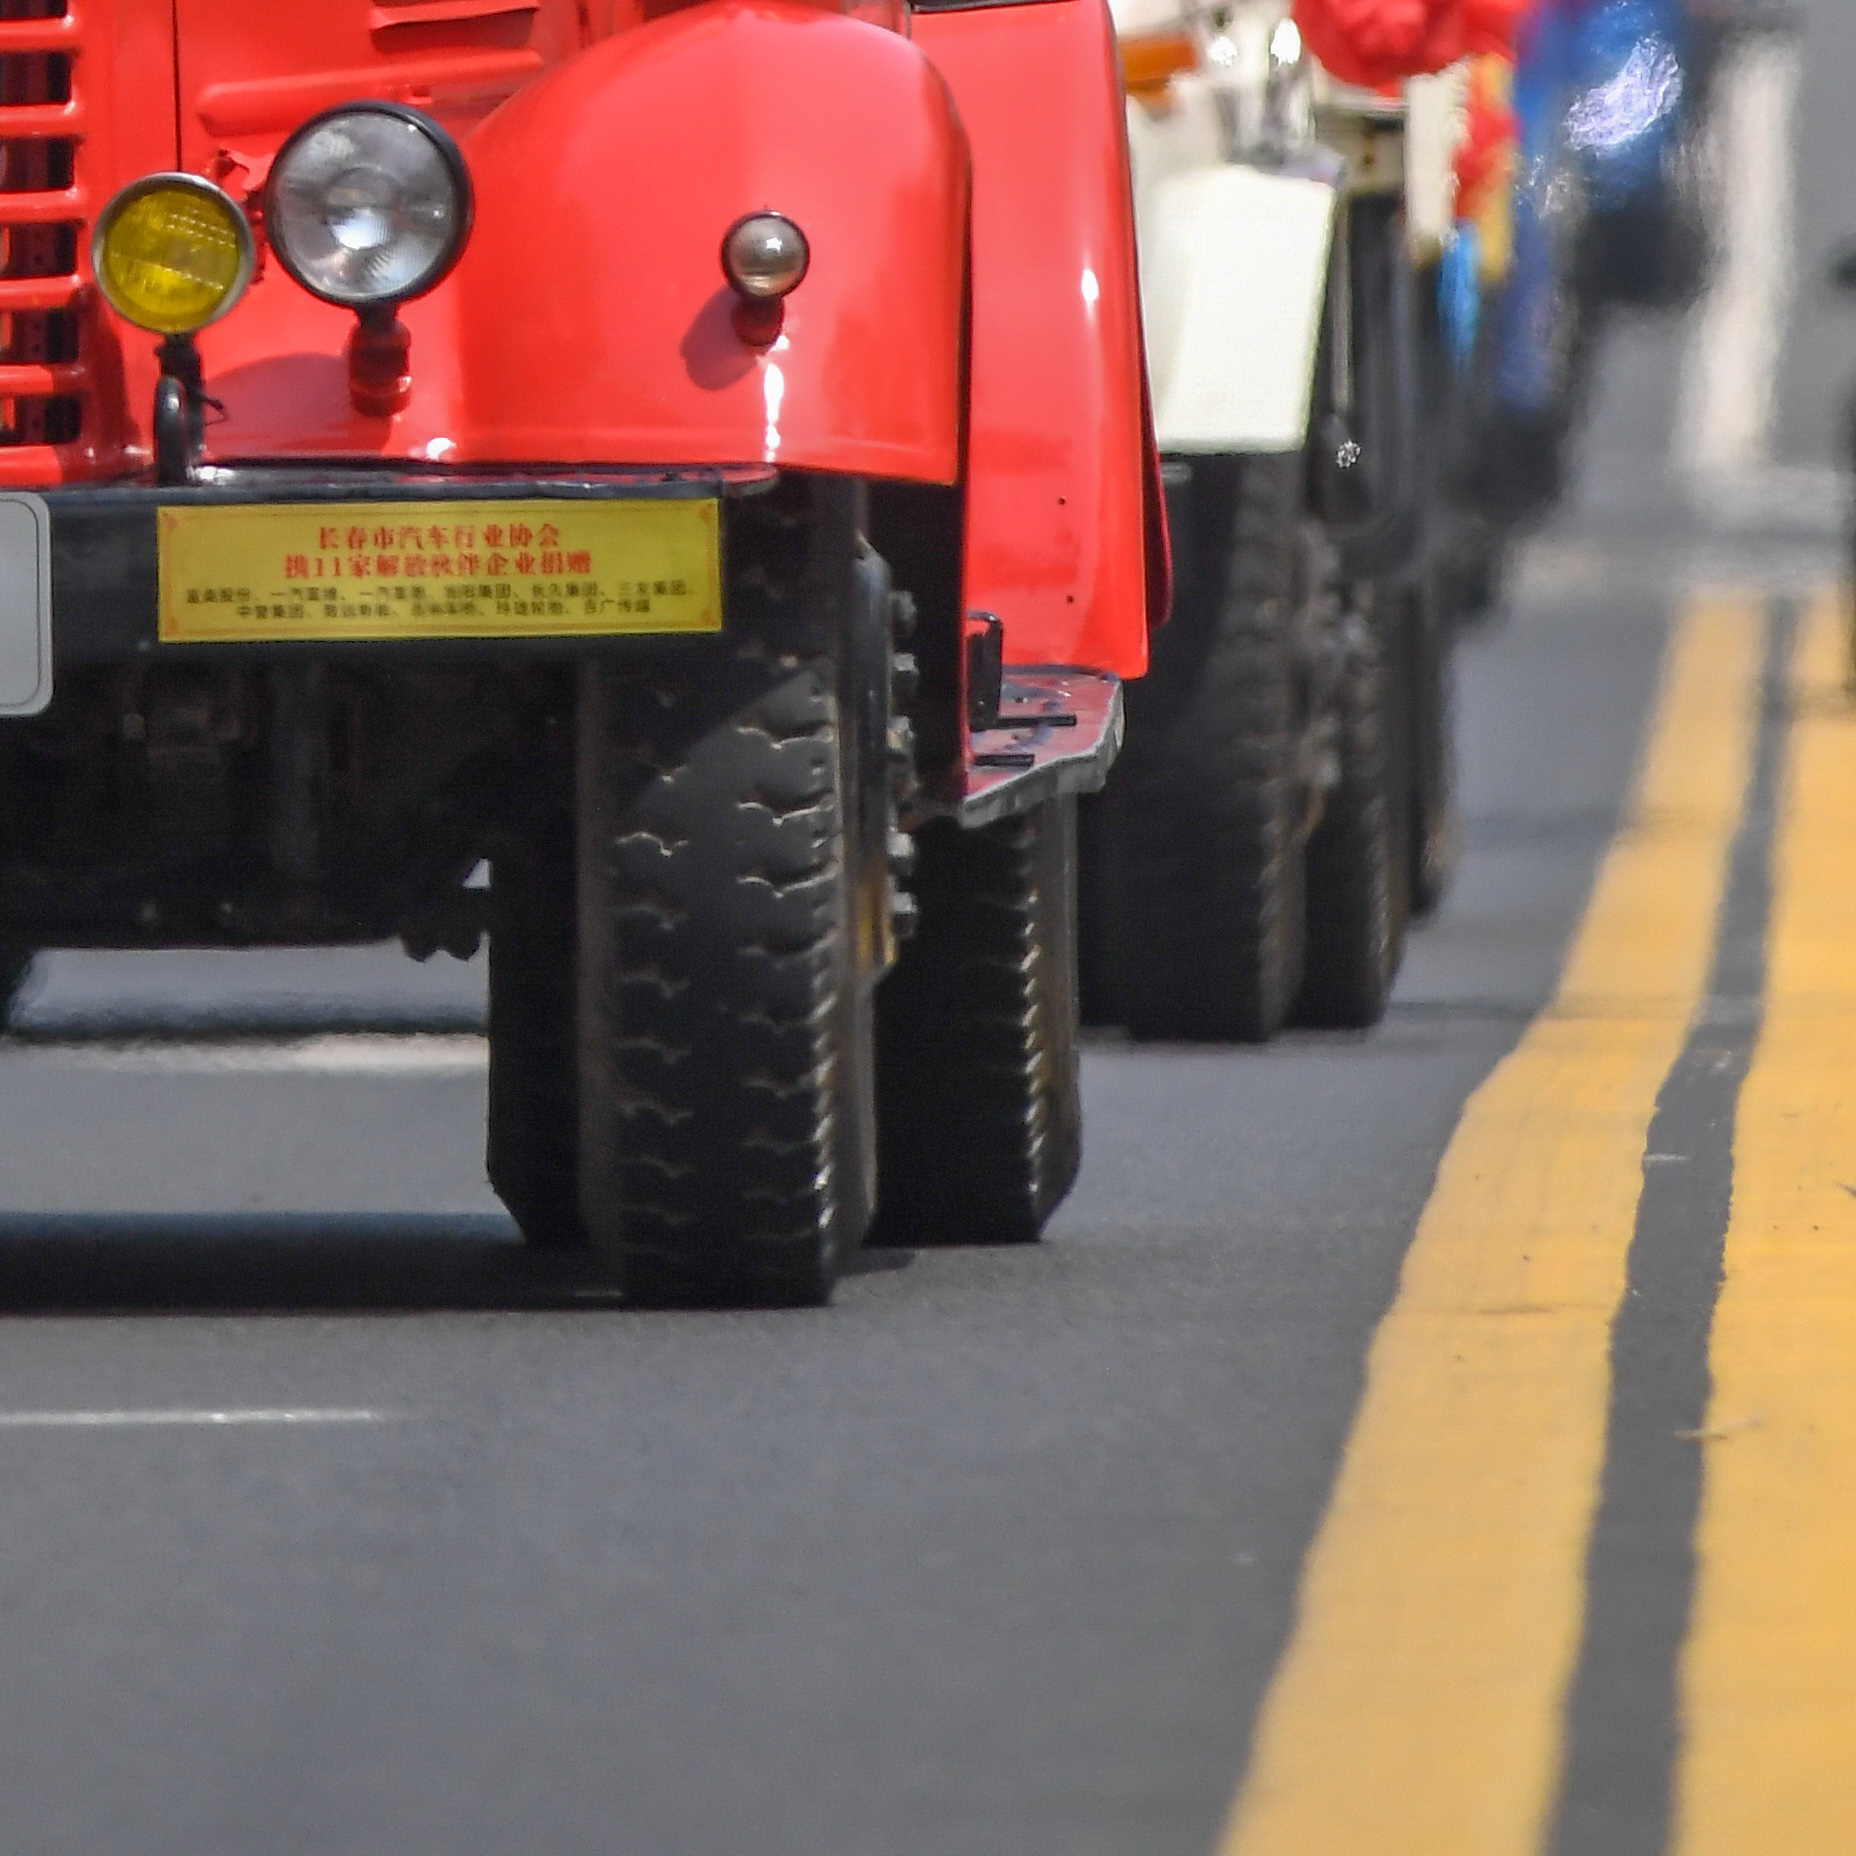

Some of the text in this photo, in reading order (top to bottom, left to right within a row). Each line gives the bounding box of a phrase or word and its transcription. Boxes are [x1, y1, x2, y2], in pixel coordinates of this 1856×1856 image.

[317, 522, 560, 550] 长春市汽车行业协会
